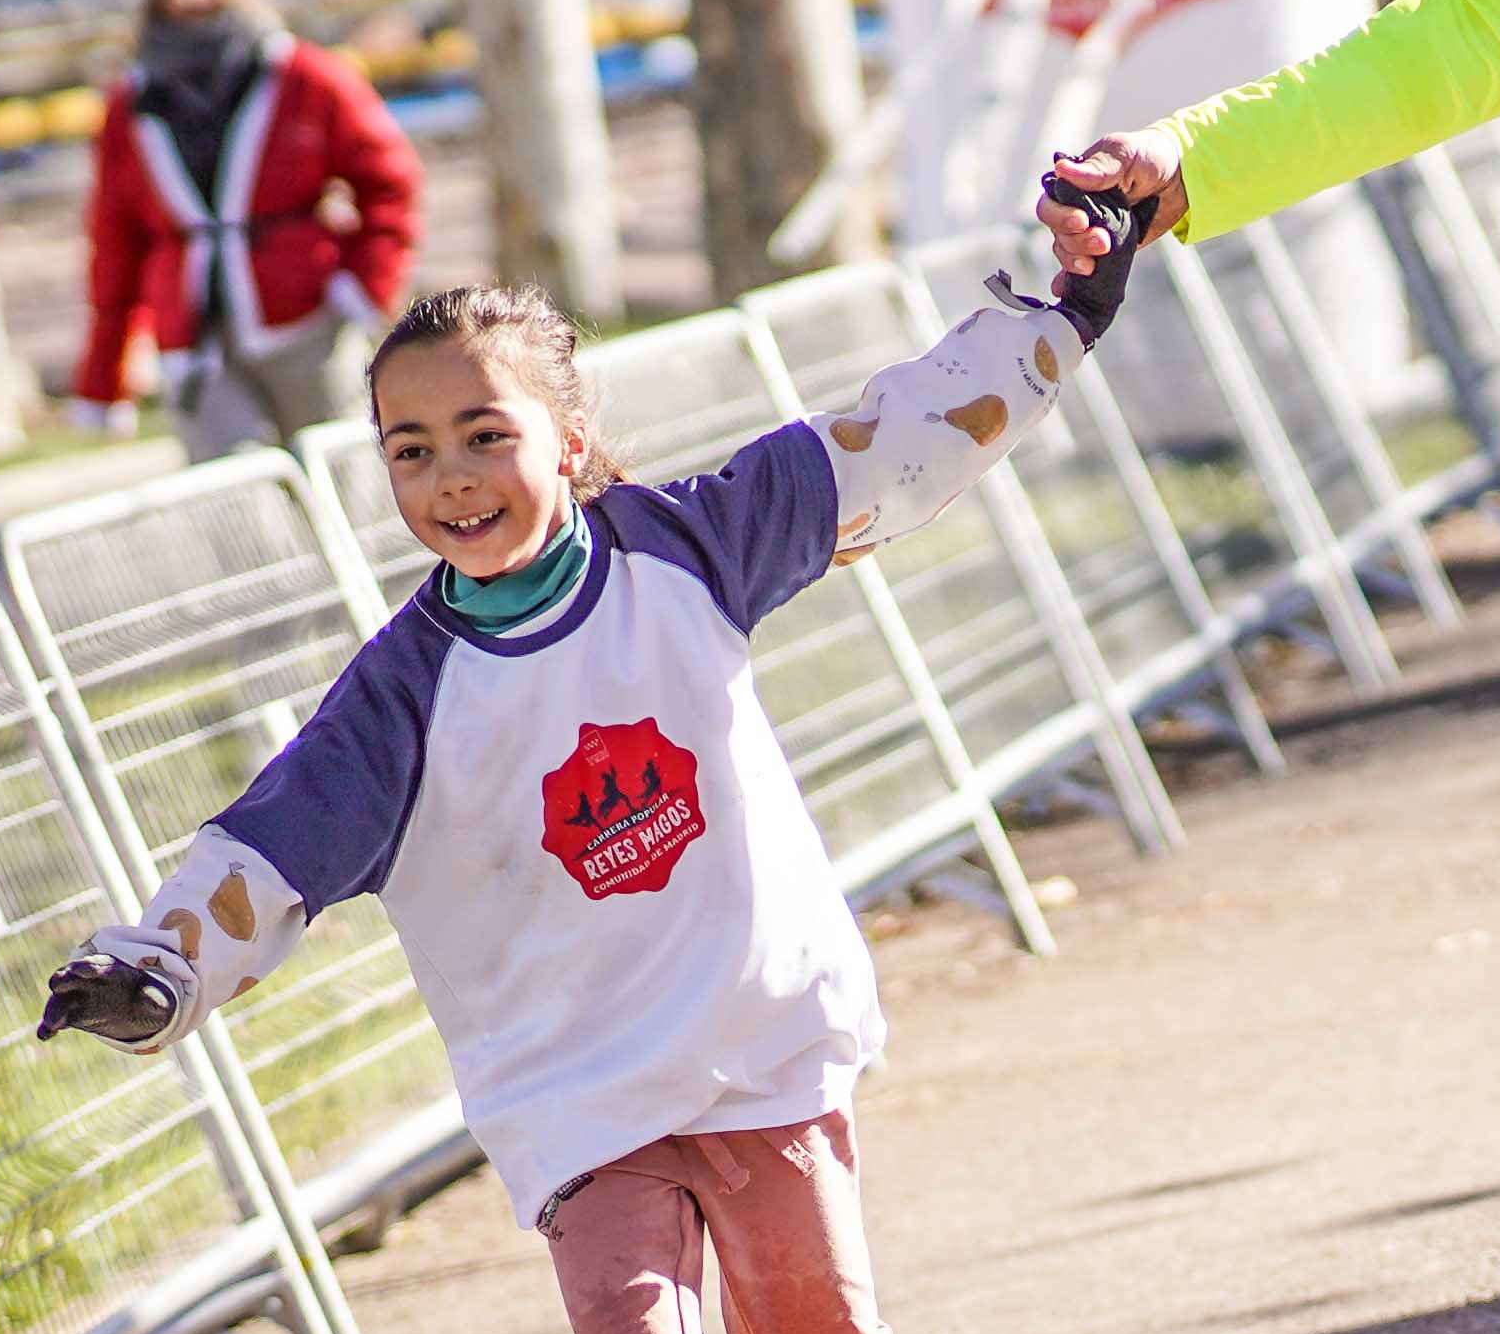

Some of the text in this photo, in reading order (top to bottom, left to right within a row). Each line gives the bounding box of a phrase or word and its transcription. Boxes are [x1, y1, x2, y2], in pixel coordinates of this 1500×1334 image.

[583, 798, 692, 881] REYES MAGOS
[587, 818, 631, 851] CARRERA
[630, 792, 670, 824] POPULAR
[593, 860, 651, 894] COMUNIDAD
[651, 848, 664, 861] DE
[663, 822, 699, 852] MADRID
